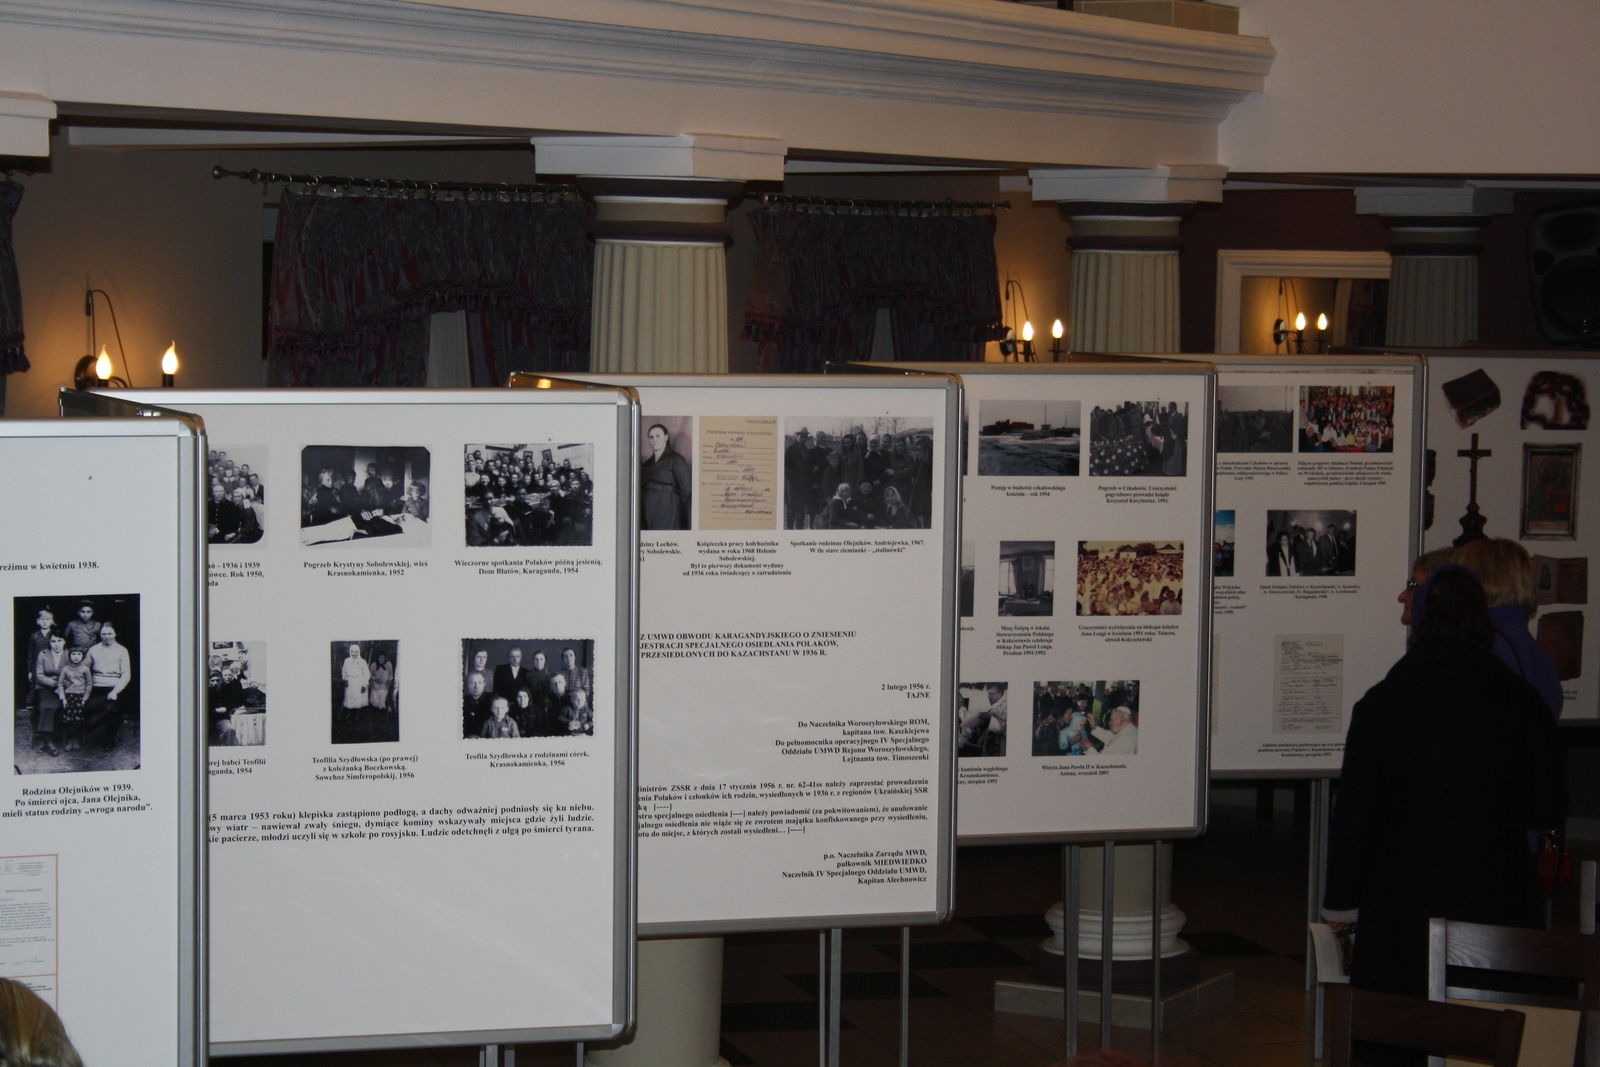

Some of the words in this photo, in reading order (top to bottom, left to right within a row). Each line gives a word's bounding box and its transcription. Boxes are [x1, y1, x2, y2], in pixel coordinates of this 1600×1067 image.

[40, 561, 76, 570] kwietniu
[78, 561, 99, 569] 1938.
[304, 561, 332, 570] Pogrzeb
[333, 561, 364, 570] Krystyny
[491, 558, 523, 567] spotkania
[555, 558, 575, 567] późną
[522, 567, 562, 576] Karaganda,
[564, 566, 579, 574] 1954
[676, 632, 714, 640] OBWODU
[715, 631, 802, 639] KARAGANDYJSKIEGO
[685, 641, 744, 649] SPECJALNEGO
[796, 639, 838, 649] POLAKÓW,
[731, 649, 791, 657] KAZACHSTANU
[887, 683, 908, 692] lutego
[909, 718, 930, 727] ROM,
[843, 728, 872, 737] kapitana
[776, 738, 785, 746] Do
[834, 736, 879, 746] operacyjnego
[890, 735, 929, 745] Specjalnego
[338, 755, 378, 765] Szydłowska
[379, 755, 391, 764] (po
[392, 755, 418, 764] prawej)
[465, 752, 488, 760] Teofila
[489, 751, 528, 761] Szydłowska
[328, 764, 363, 774] koleżanką
[22, 786, 56, 796] Rodzina
[58, 784, 100, 796] Olejników
[113, 783, 133, 792] 1939.
[15, 798, 26, 806] Po
[28, 797, 58, 806] śmierci
[60, 796, 79, 807] ojca,
[81, 795, 101, 804] Jana
[103, 793, 140, 805] Olejnika,
[2, 809, 23, 818] mieli
[25, 807, 49, 817] status
[51, 806, 82, 818] rodziny
[85, 807, 115, 816] „wroga
[116, 802, 153, 812] narodu”.
[208, 813, 217, 823] (5
[250, 811, 269, 820] 1953
[272, 811, 296, 822] roku)
[298, 810, 334, 821] klepiska
[336, 809, 381, 820] zastąpiono
[383, 808, 419, 819] podłogą,
[429, 807, 453, 818] dachy
[456, 806, 498, 817] odważniej
[500, 805, 539, 816] podniosły
[542, 804, 553, 815] się
[556, 804, 567, 812] ku
[570, 803, 594, 812] niebu.
[226, 822, 248, 831] wiatr
[304, 820, 327, 831] zwały
[332, 820, 361, 830] śniegu,
[364, 819, 399, 830] dymiące
[403, 818, 433, 829] kominy
[438, 816, 486, 828] wskazywały
[490, 815, 521, 826] miejsca
[524, 815, 546, 826] gdzie
[550, 814, 564, 825] żyli
[568, 814, 594, 822] ludzie.
[221, 833, 260, 844] pacierze,
[261, 832, 290, 841] młodzi
[292, 832, 316, 843] uczyli
[318, 831, 329, 842] się
[341, 830, 367, 839] szkole
[368, 832, 379, 840] po
[381, 829, 420, 840] rosyjsku.
[421, 828, 449, 837] Ludzie
[451, 827, 493, 838] odetchnęli
[502, 826, 519, 837] ulgą
[521, 828, 532, 836] po
[534, 825, 563, 834] śmierci
[565, 824, 594, 835] tyrana.
[838, 850, 874, 858] Naczelnika
[875, 849, 904, 859] Zarządu
[905, 849, 927, 857] MWD,
[873, 857, 927, 865] MIEDWIEDKO
[858, 876, 885, 885] Kapitan
[886, 875, 927, 883] Alechnowicz
